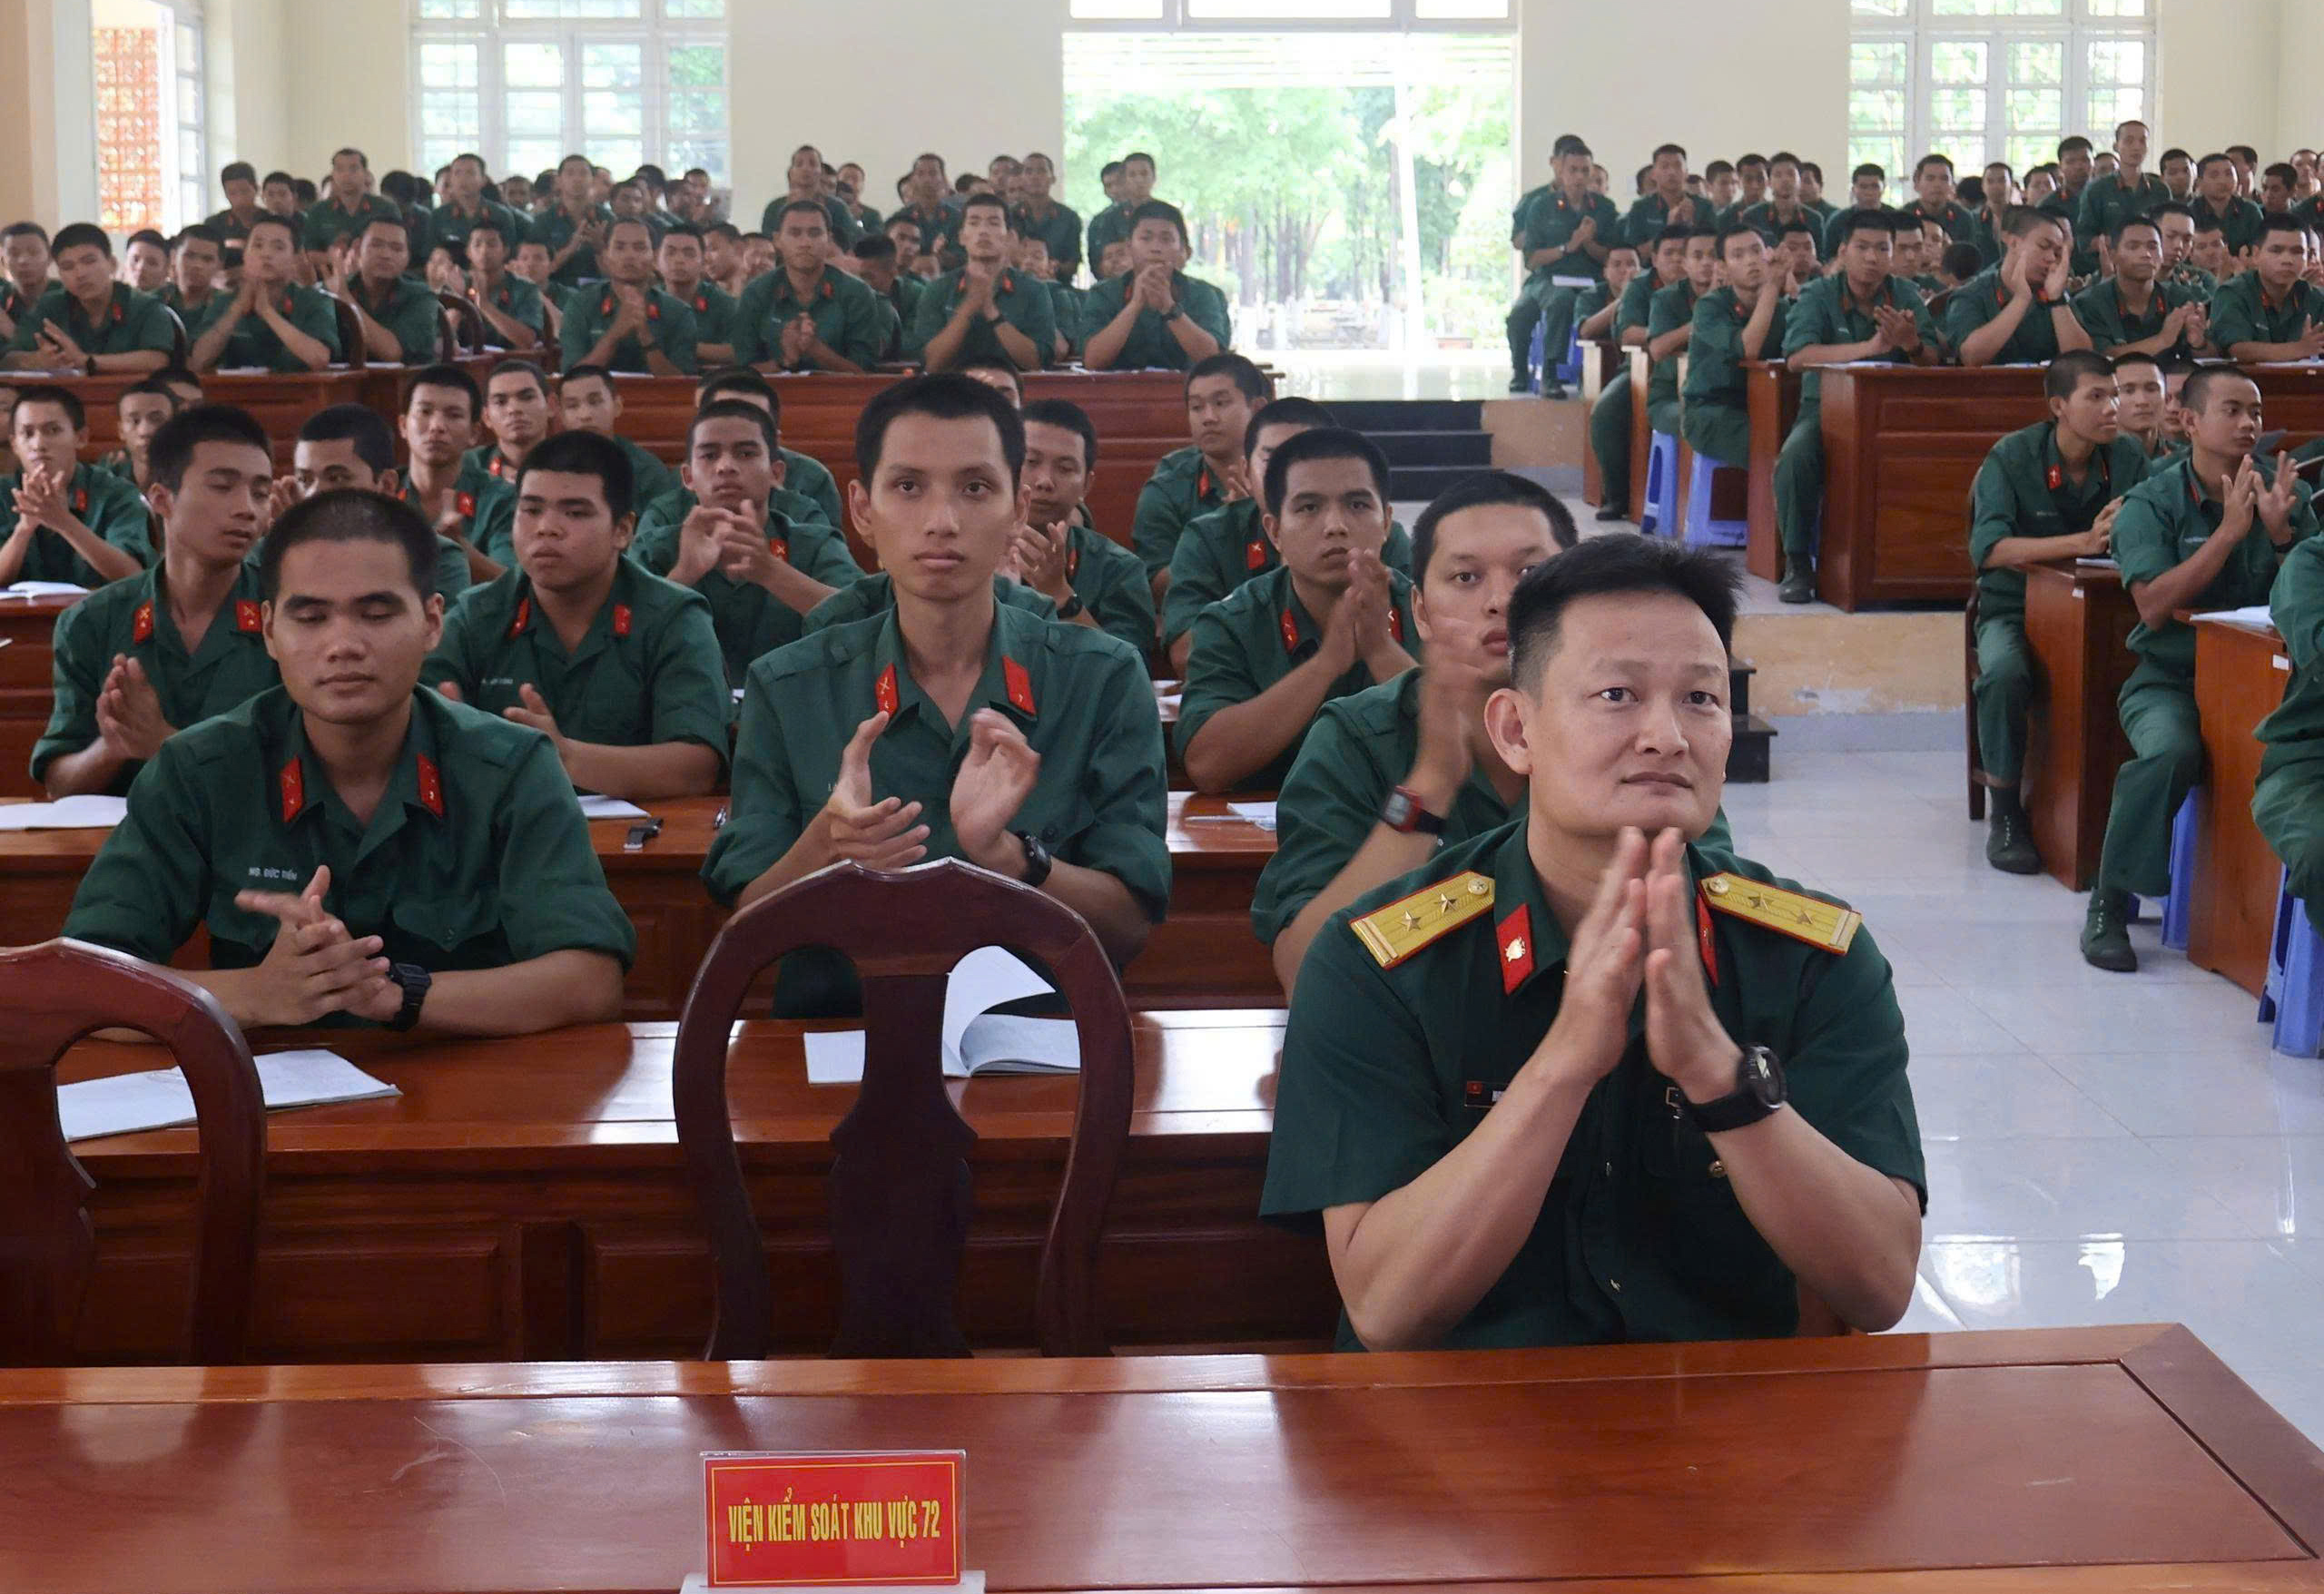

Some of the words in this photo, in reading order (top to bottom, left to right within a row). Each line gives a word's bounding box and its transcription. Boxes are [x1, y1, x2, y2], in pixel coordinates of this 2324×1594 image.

[727, 1497, 764, 1552] VIỆN
[767, 1486, 806, 1542] KIỂM
[811, 1493, 850, 1541] SOÁT
[854, 1501, 882, 1540] KHU
[887, 1494, 917, 1549] VỰC
[921, 1499, 941, 1539] 72
